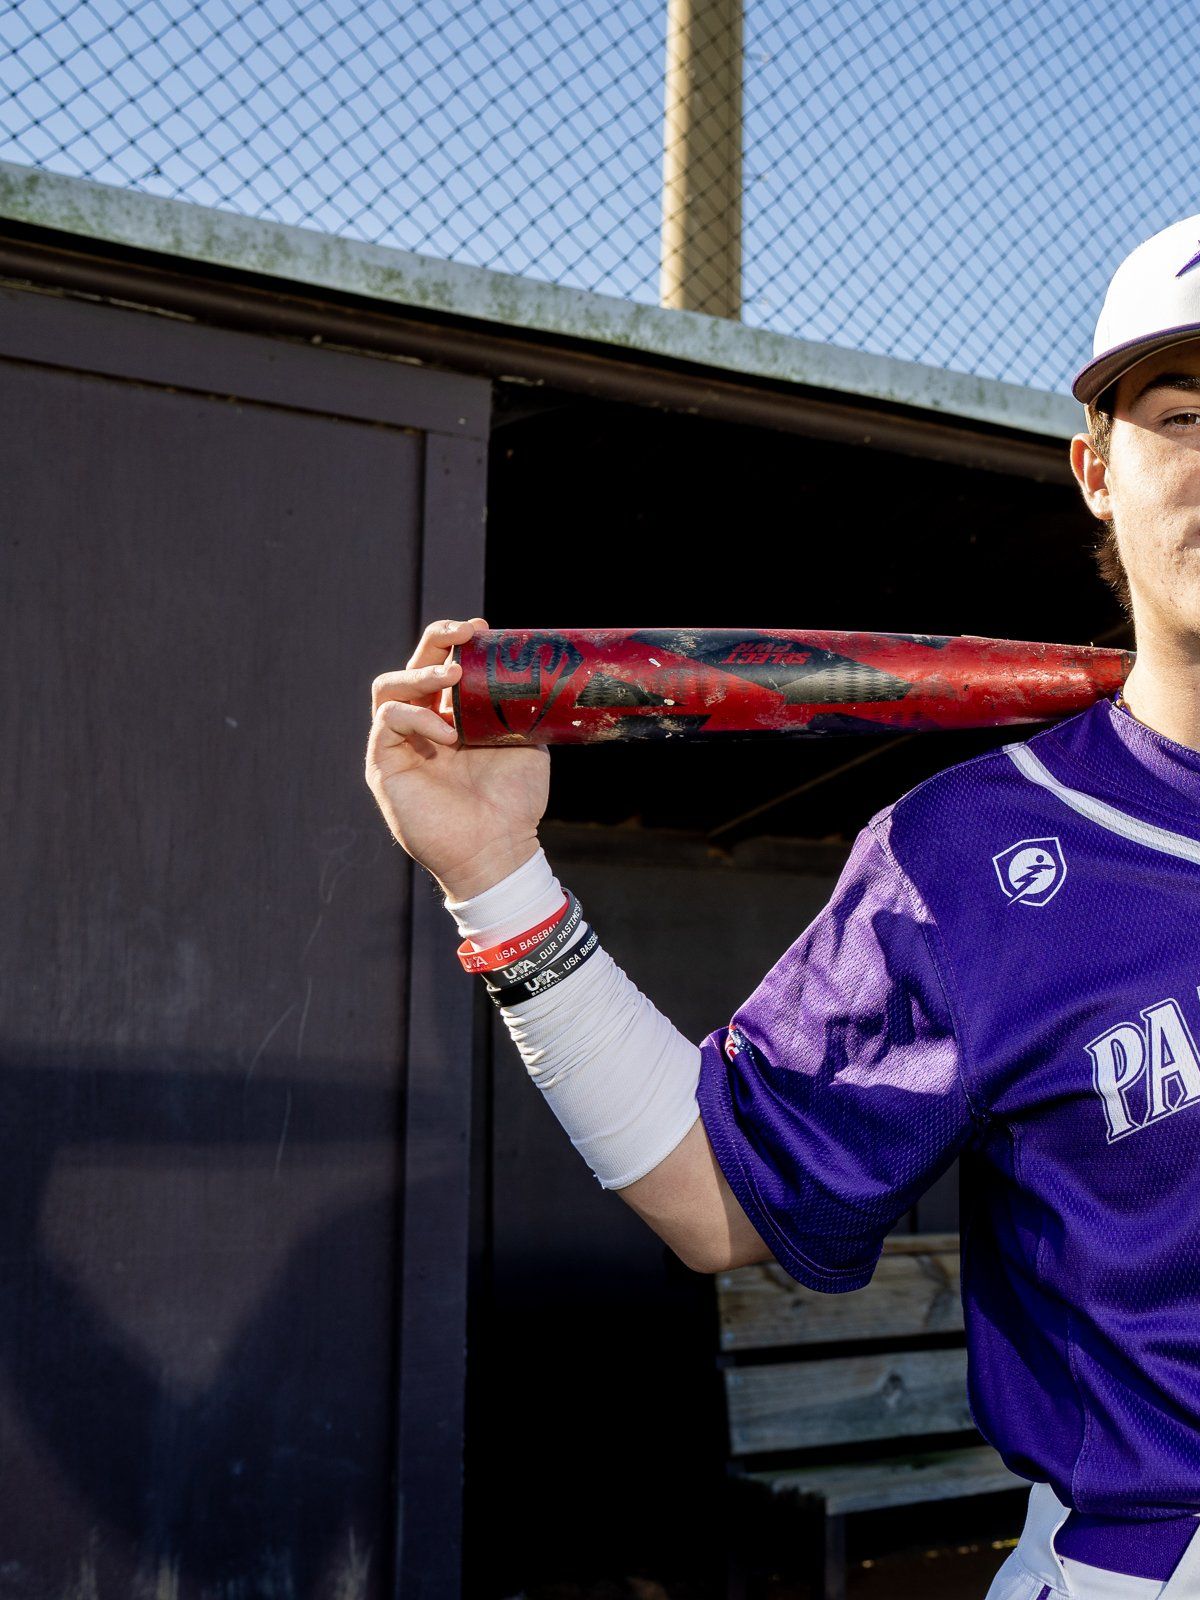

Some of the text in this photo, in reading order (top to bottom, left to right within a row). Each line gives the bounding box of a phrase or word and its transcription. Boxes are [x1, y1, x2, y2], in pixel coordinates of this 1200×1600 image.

[495, 921, 560, 961] USA BASEBA
[539, 941, 559, 960] OUR
[562, 953, 582, 970] USA
